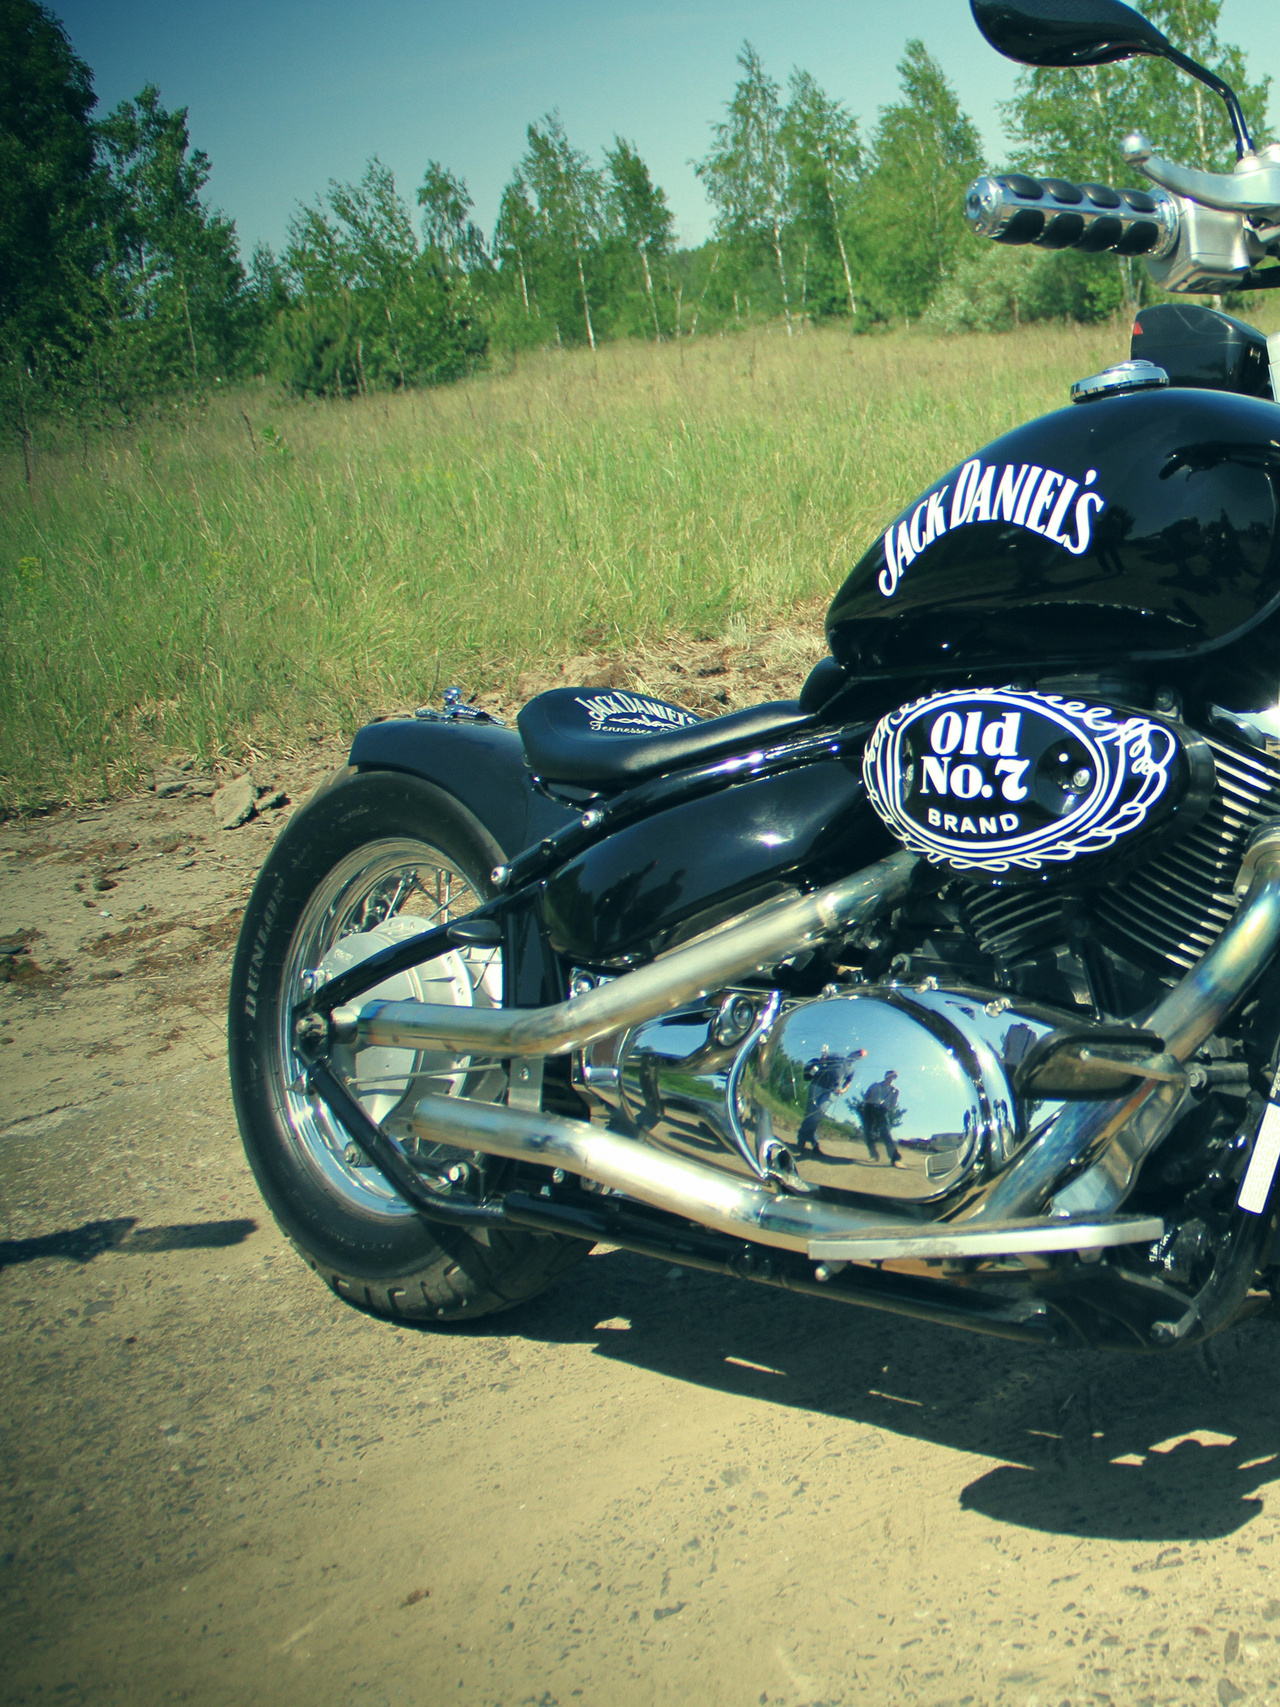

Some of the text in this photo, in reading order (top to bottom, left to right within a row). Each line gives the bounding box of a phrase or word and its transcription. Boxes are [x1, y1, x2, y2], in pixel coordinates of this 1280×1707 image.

[878, 458, 1105, 597] JACK DANIEL'S
[574, 695, 618, 721] JACK
[589, 720, 652, 734] Tennessee
[930, 711, 1022, 757] Old
[919, 755, 1030, 801] No.7
[927, 807, 1020, 834] BRAND
[244, 877, 285, 1019] DUNLOP
